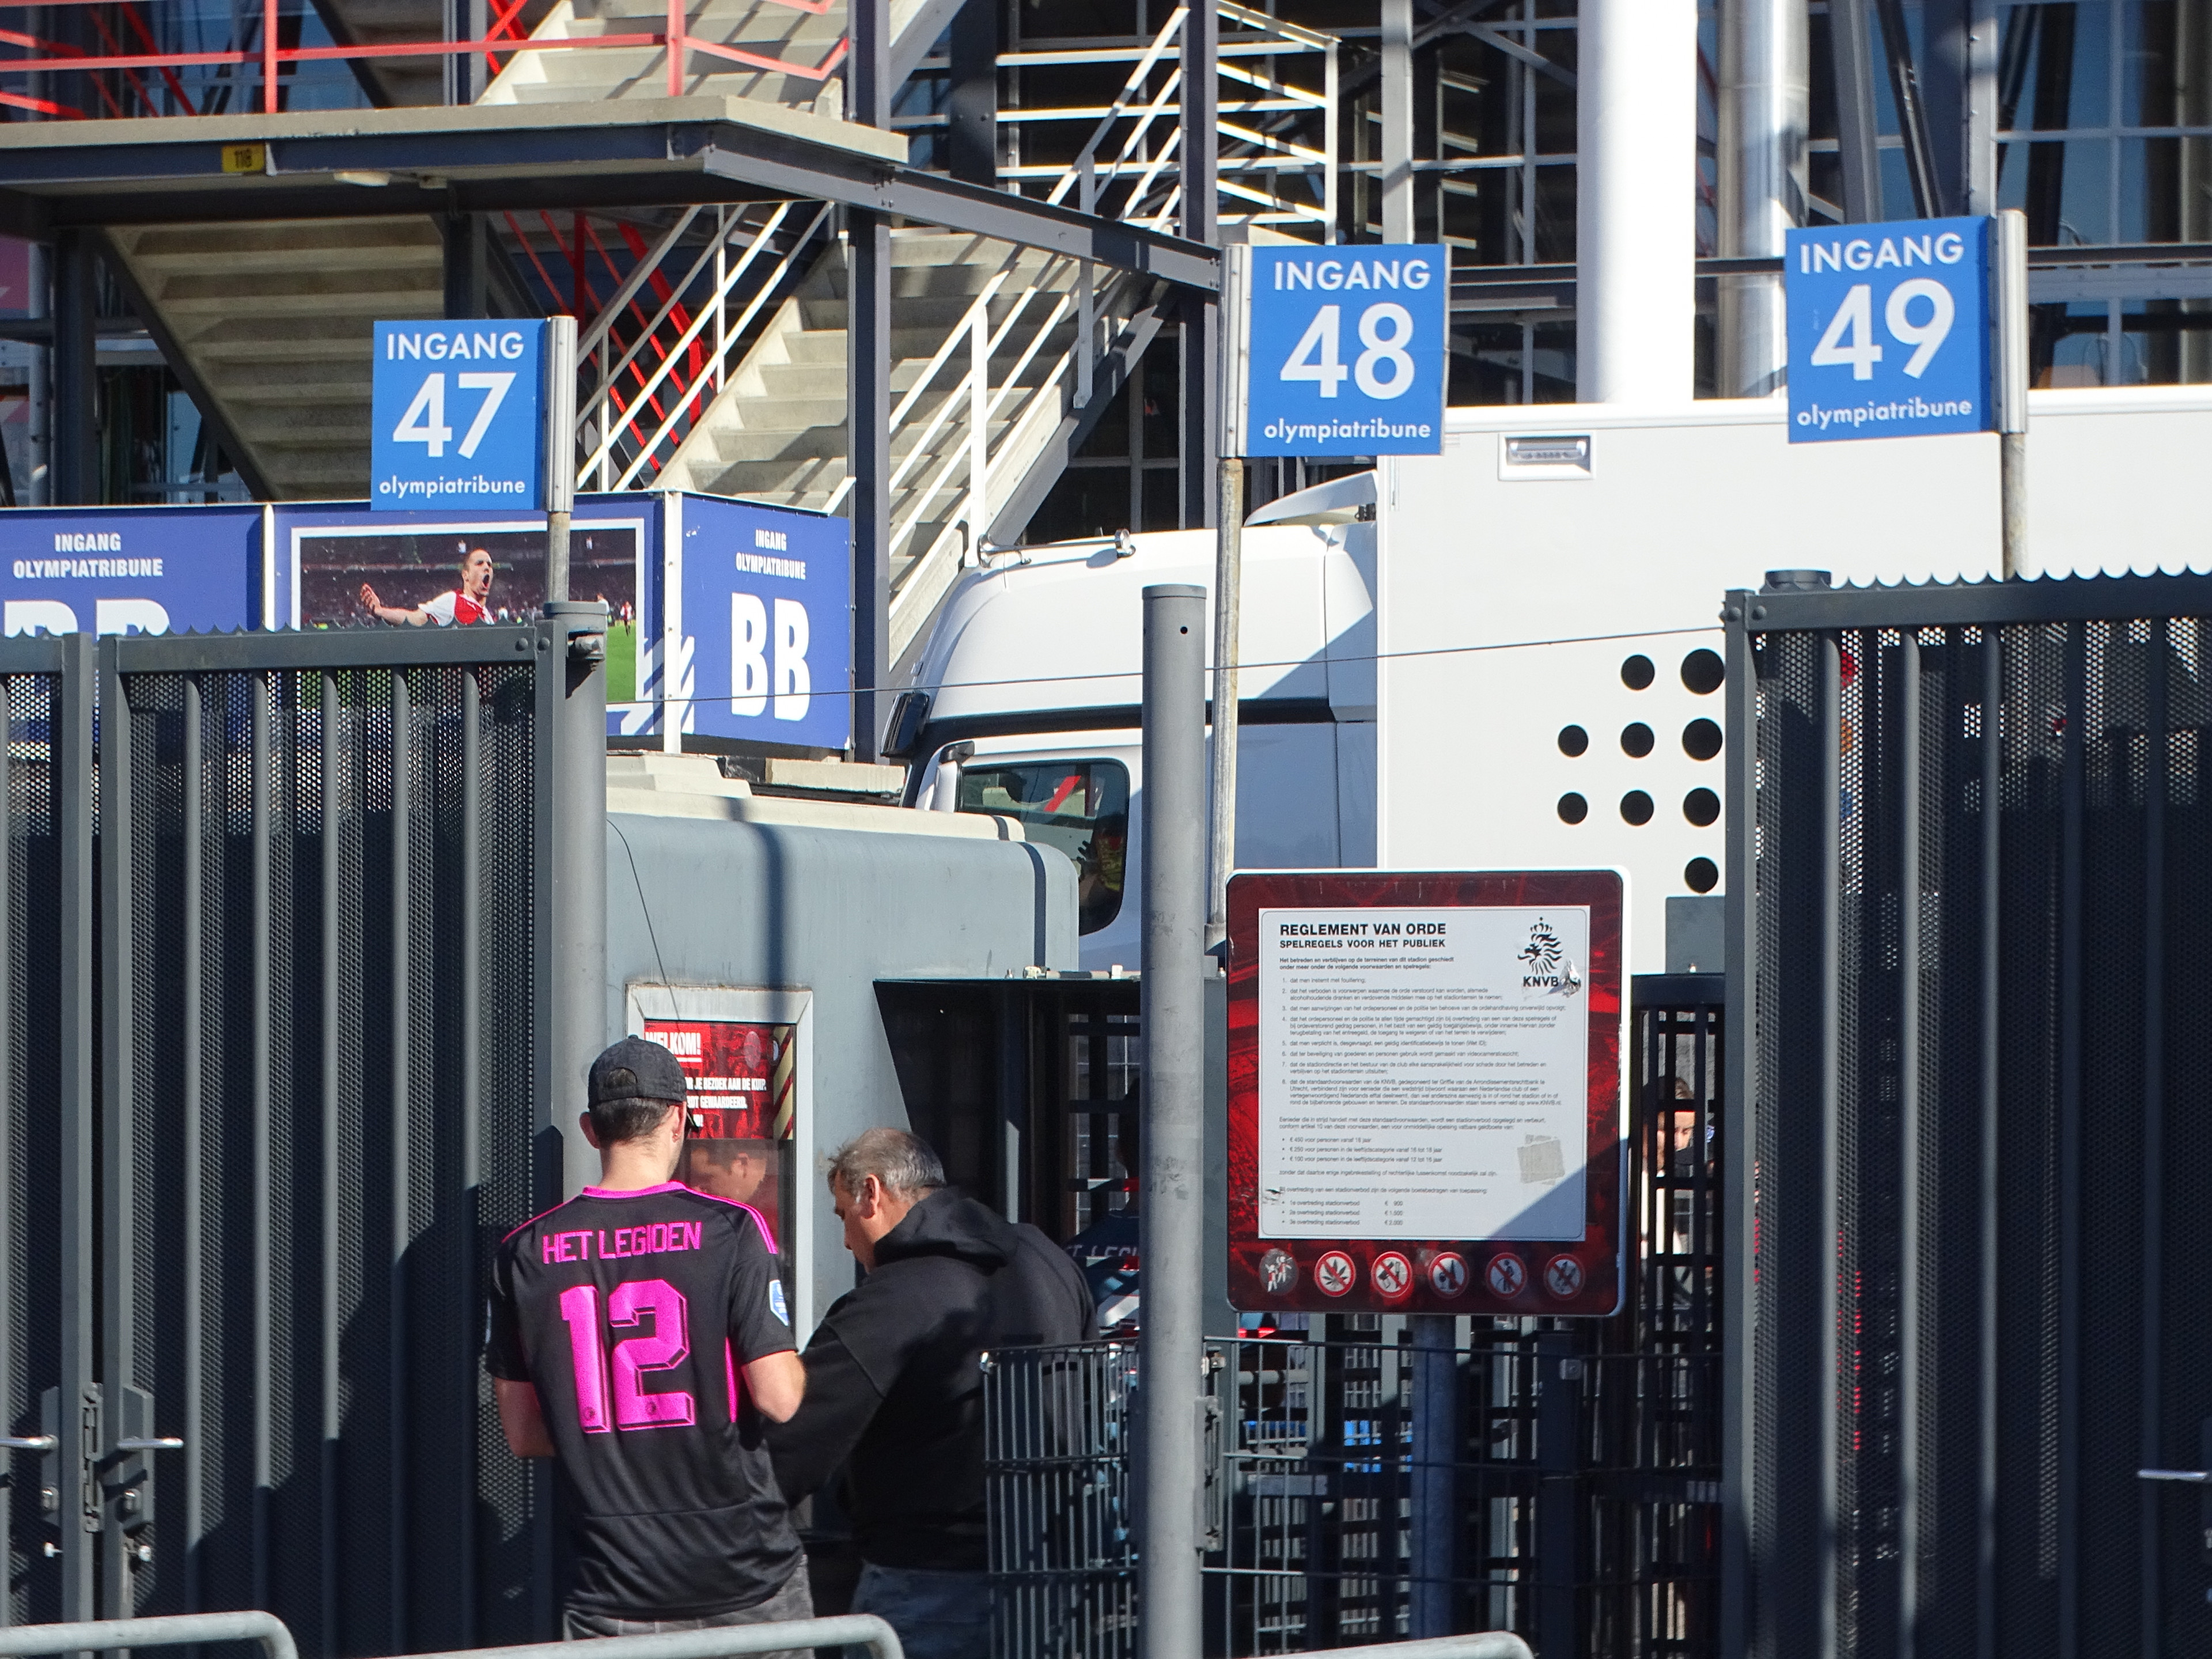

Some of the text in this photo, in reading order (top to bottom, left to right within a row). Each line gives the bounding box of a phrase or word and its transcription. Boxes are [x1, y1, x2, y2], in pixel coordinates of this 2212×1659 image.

[1800, 232, 1964, 274] INGANG
[1274, 260, 1430, 290] INGANG
[1810, 278, 1956, 381] 49
[387, 331, 524, 361] INGANG
[1280, 302, 1415, 400] 48
[393, 372, 517, 459] 47
[1797, 396, 1972, 430] olympiatribune
[1264, 418, 1431, 444] olympiatribune
[379, 475, 525, 499] olympiatribune
[55, 533, 122, 552] INGANG
[755, 528, 787, 551] INGANG
[13, 558, 163, 578] OLYMPIATRIBUNE
[736, 552, 806, 581] OLYMPIATRIBUNE
[731, 592, 810, 721] BB
[1279, 923, 1446, 936] REGLEMENT VAN ORDE
[1279, 938, 1446, 949] SPELREGELS VOOR HET PUBLIEK
[1522, 976, 1559, 987] KNVB
[694, 1077, 703, 1090] JE
[703, 1077, 728, 1090] BEZOEK
[728, 1077, 741, 1090] AAN
[741, 1077, 751, 1091] DE
[543, 1221, 702, 1264] HET LEGIOEN
[559, 1278, 696, 1434] 12
